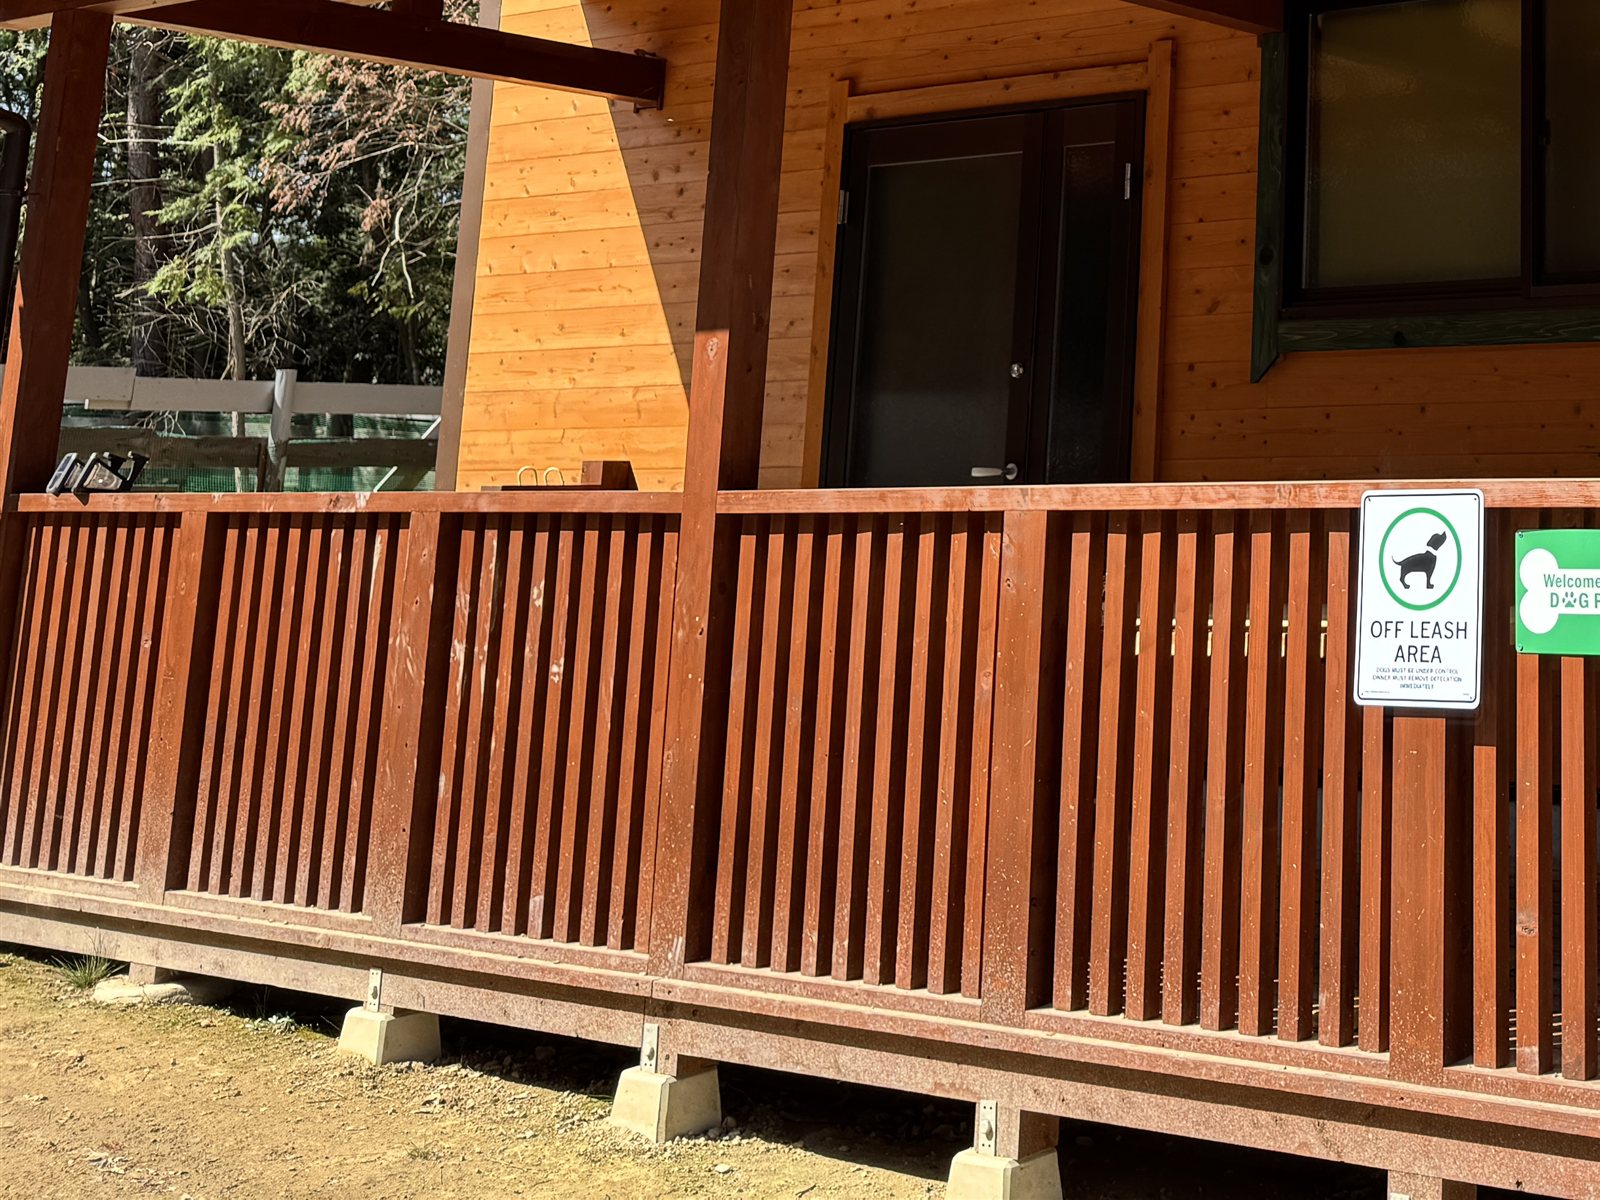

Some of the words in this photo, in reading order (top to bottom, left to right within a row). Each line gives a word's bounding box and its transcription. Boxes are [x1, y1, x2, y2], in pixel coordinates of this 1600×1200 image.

[1371, 620, 1403, 639] OFF
[1410, 620, 1468, 640] LEASH
[1394, 645, 1442, 664] AREA
